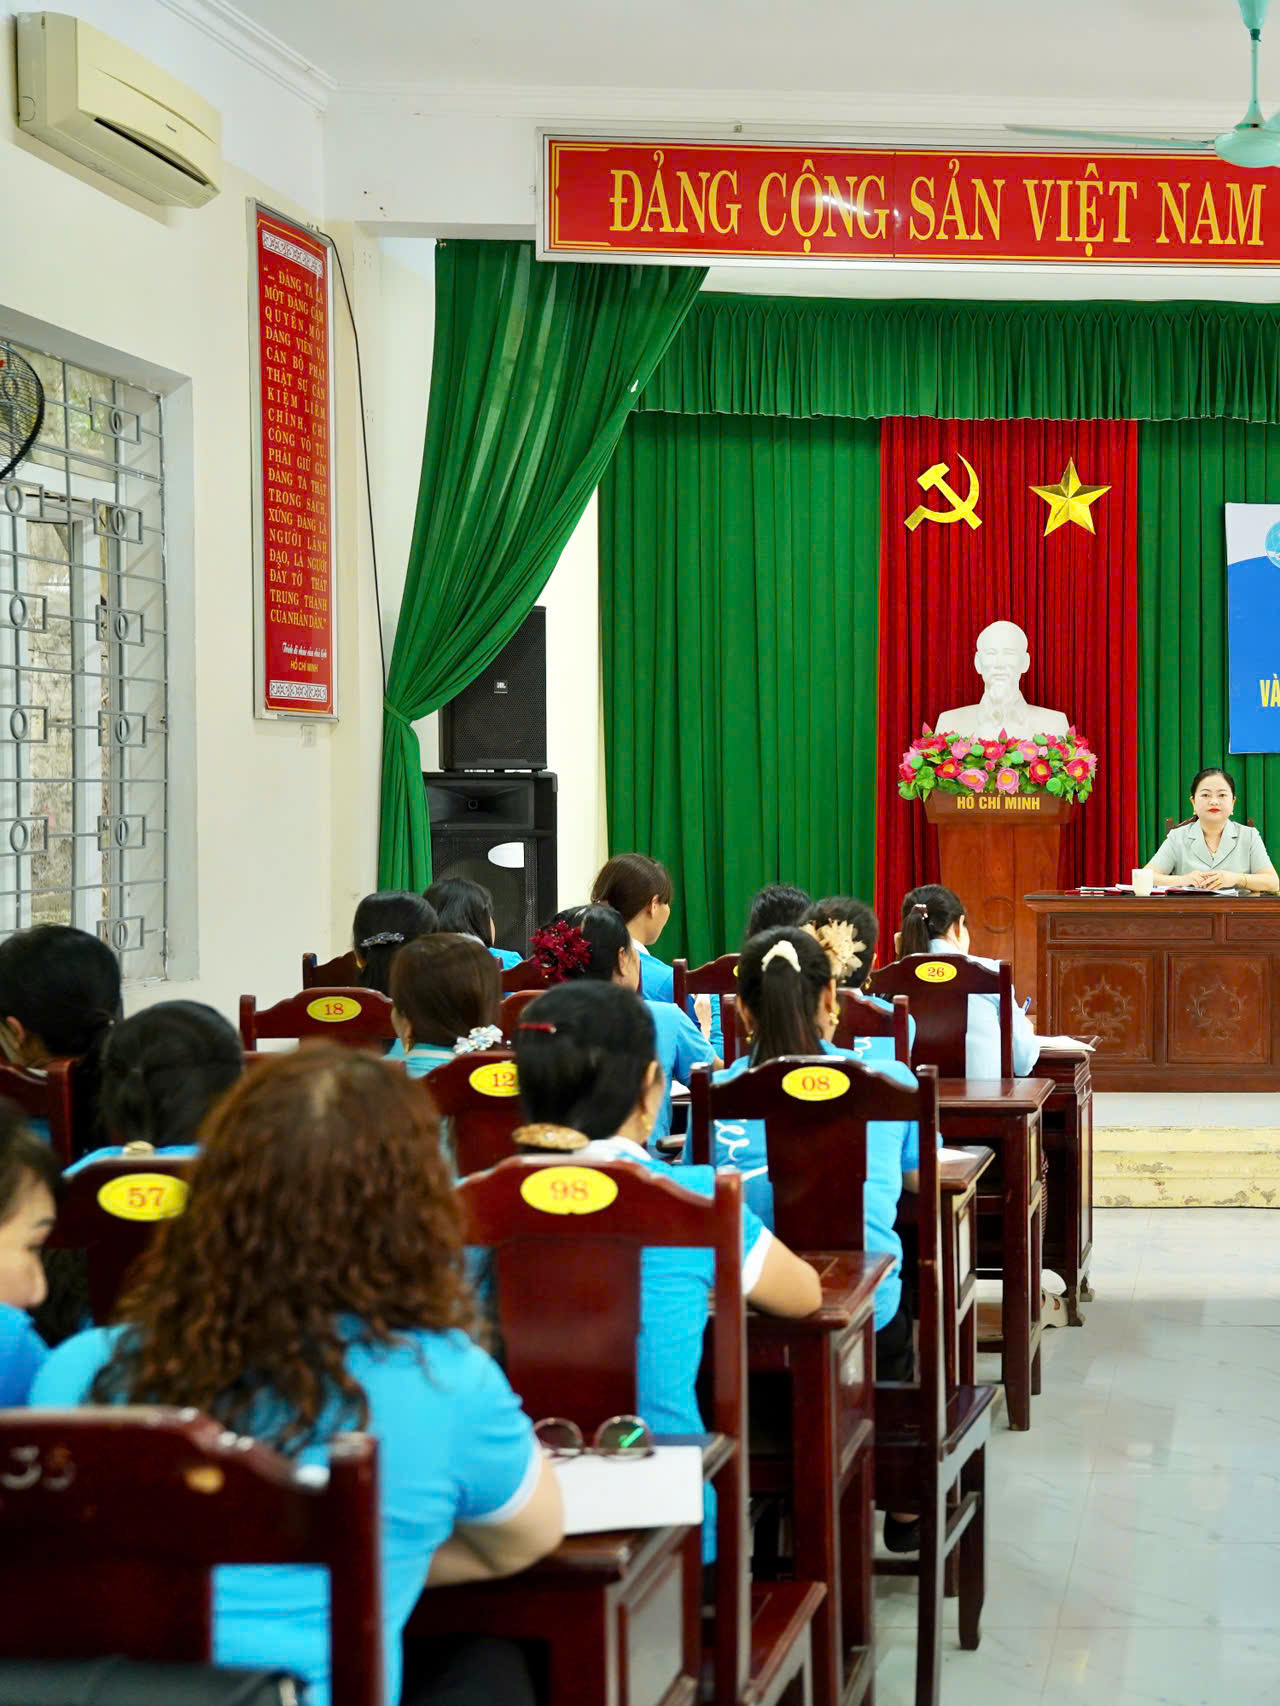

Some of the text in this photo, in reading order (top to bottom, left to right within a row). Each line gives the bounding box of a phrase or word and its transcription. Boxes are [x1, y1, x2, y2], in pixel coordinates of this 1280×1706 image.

[610, 150, 741, 233] ĐẢNG
[758, 160, 888, 253] CỘNG
[910, 159, 1005, 241] SẢN
[1023, 163, 1138, 256] VIỆT
[1157, 183, 1265, 245] NAM
[265, 285, 284, 305] MỘT
[287, 292, 308, 315] ĐẢNG
[266, 345, 286, 364] CÁN
[267, 367, 292, 386] THẬT
[268, 426, 295, 447] CÔNG
[268, 447, 291, 466] PHẢI
[268, 465, 292, 485] ĐẢNG
[298, 476, 307, 490] TA
[269, 488, 301, 507] TRONG
[270, 589, 299, 606] TRUNG
[1004, 796, 1040, 811] MINH
[927, 966, 944, 980] 26
[324, 1002, 345, 1018] 18
[491, 1071, 515, 1089] 12
[801, 1074, 830, 1093] 08
[126, 1186, 168, 1210] 57
[547, 1179, 590, 1203] 98
